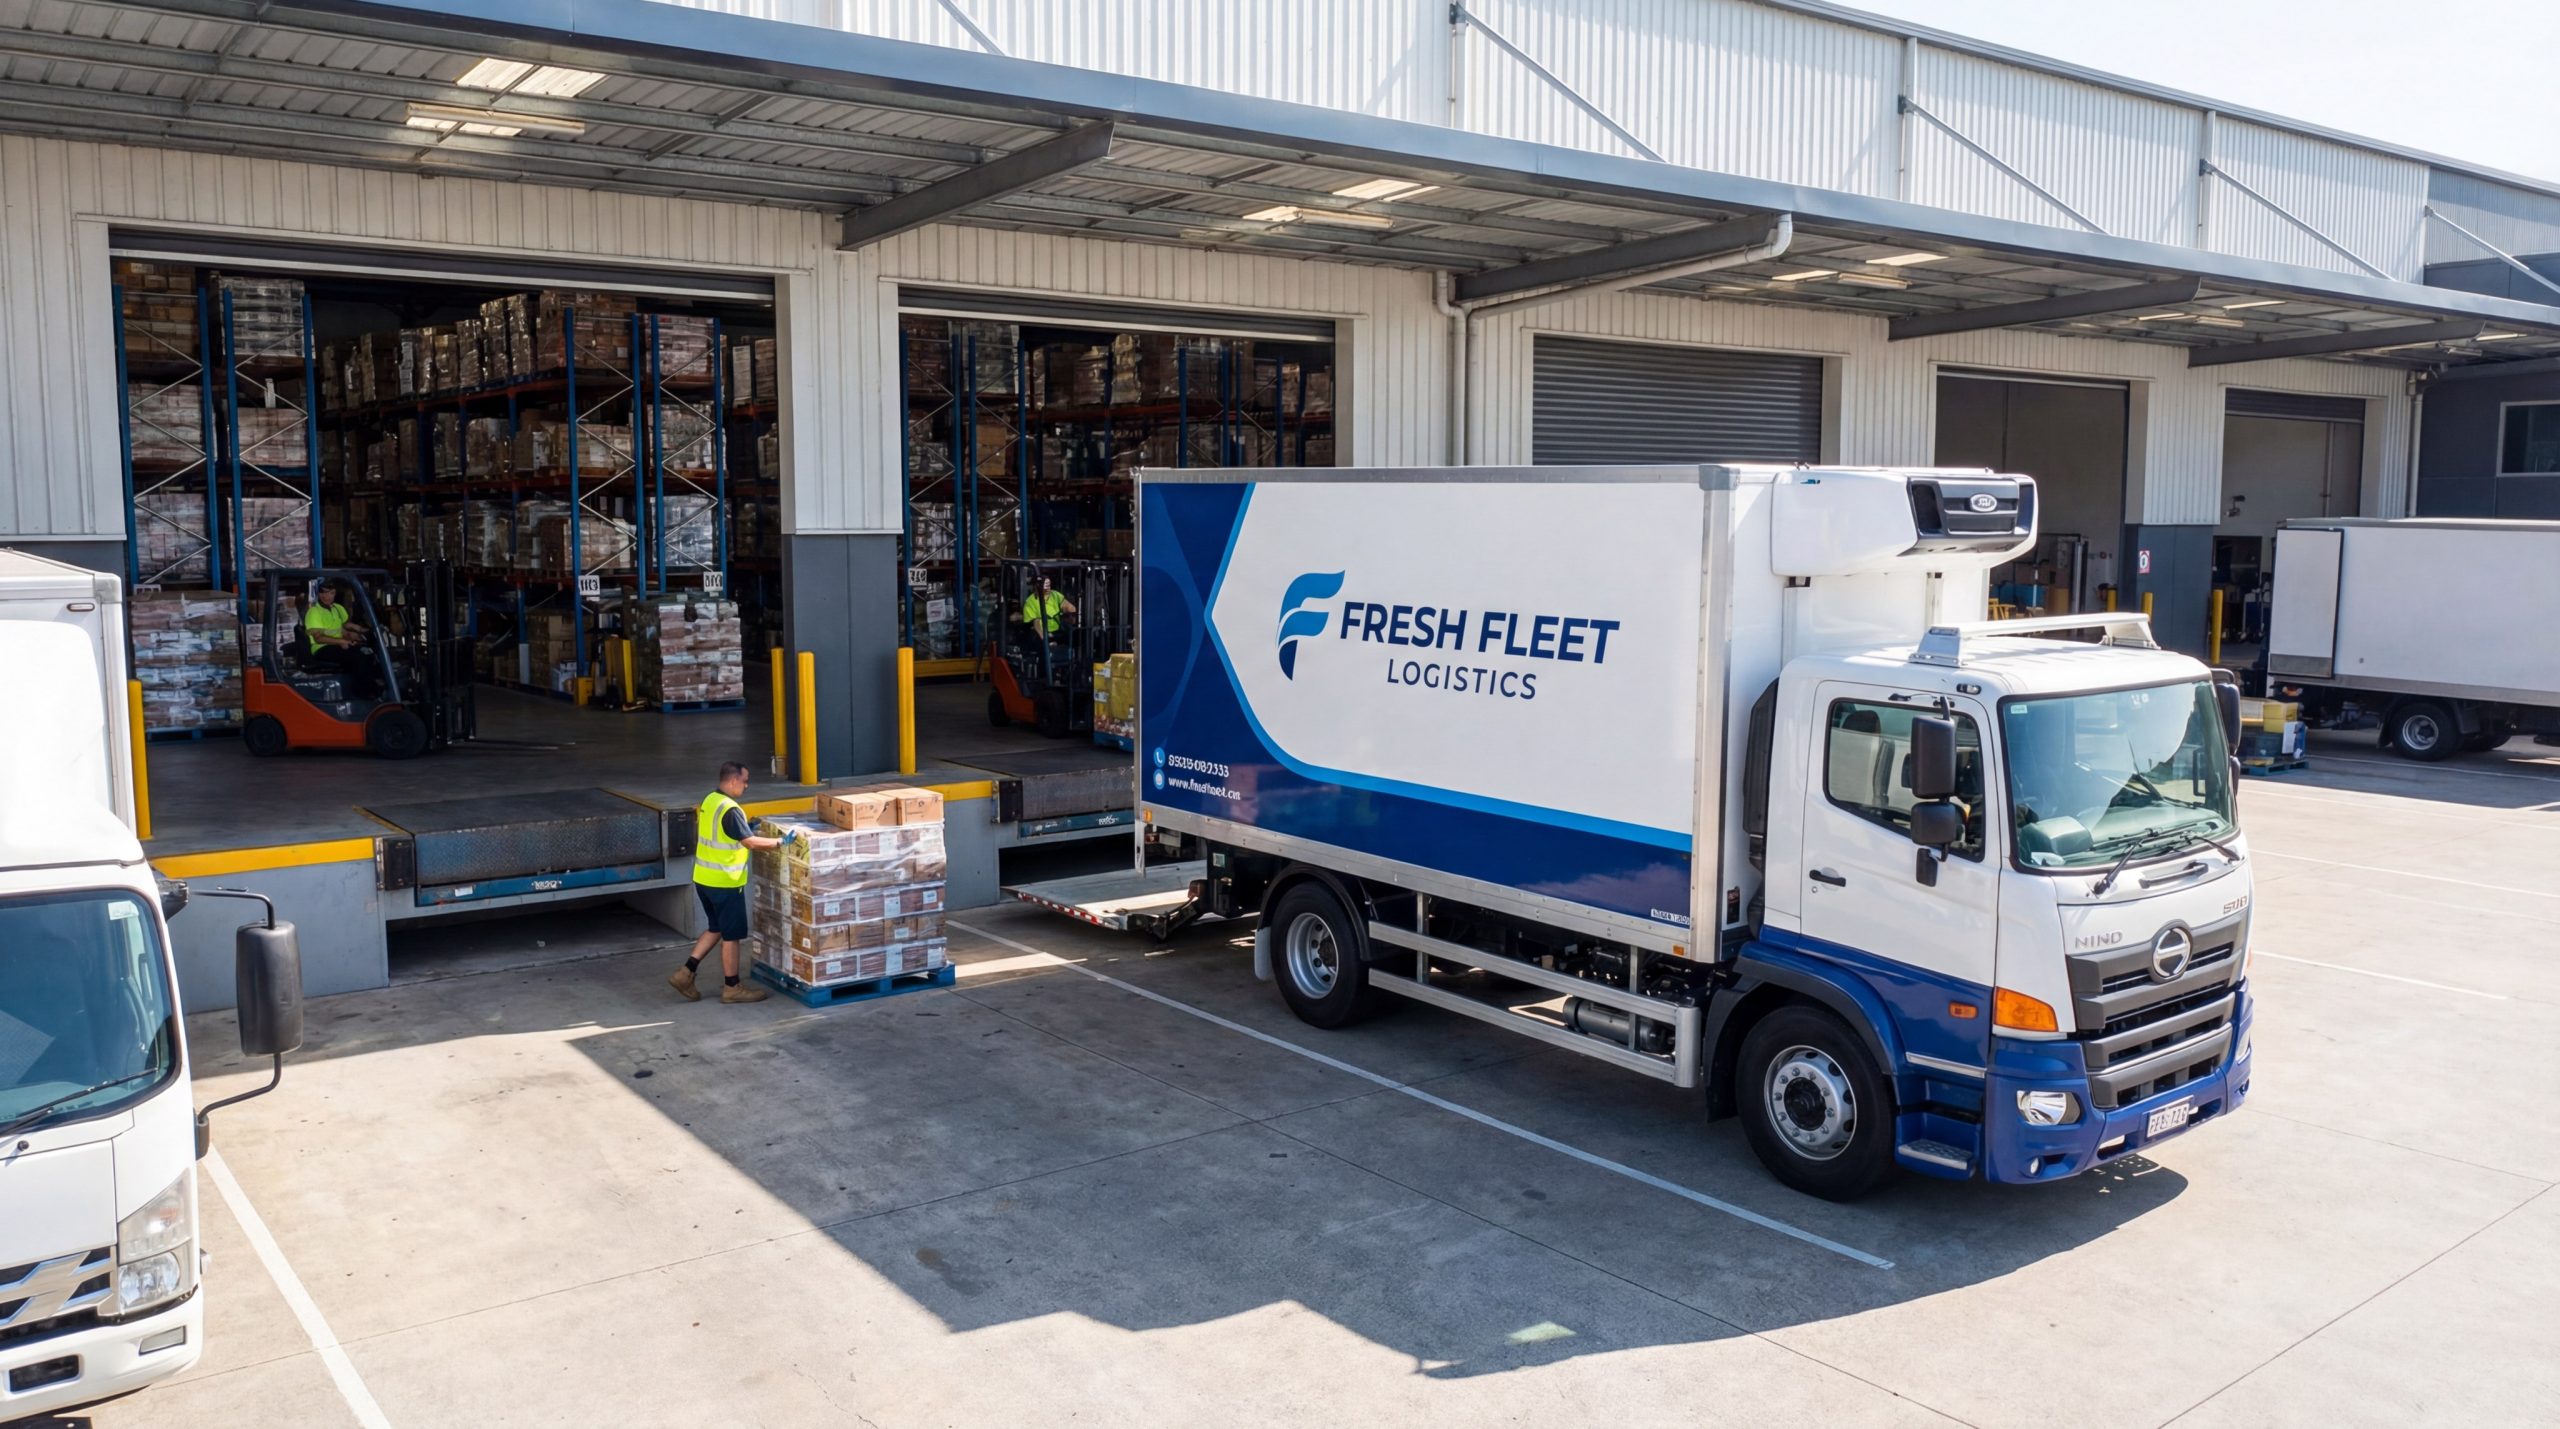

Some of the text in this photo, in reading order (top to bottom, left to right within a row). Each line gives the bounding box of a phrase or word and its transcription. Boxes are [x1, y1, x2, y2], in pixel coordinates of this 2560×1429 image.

[1340, 602, 1621, 664] FRESH FLEET
[1387, 658, 1538, 701] LOGISTICS
